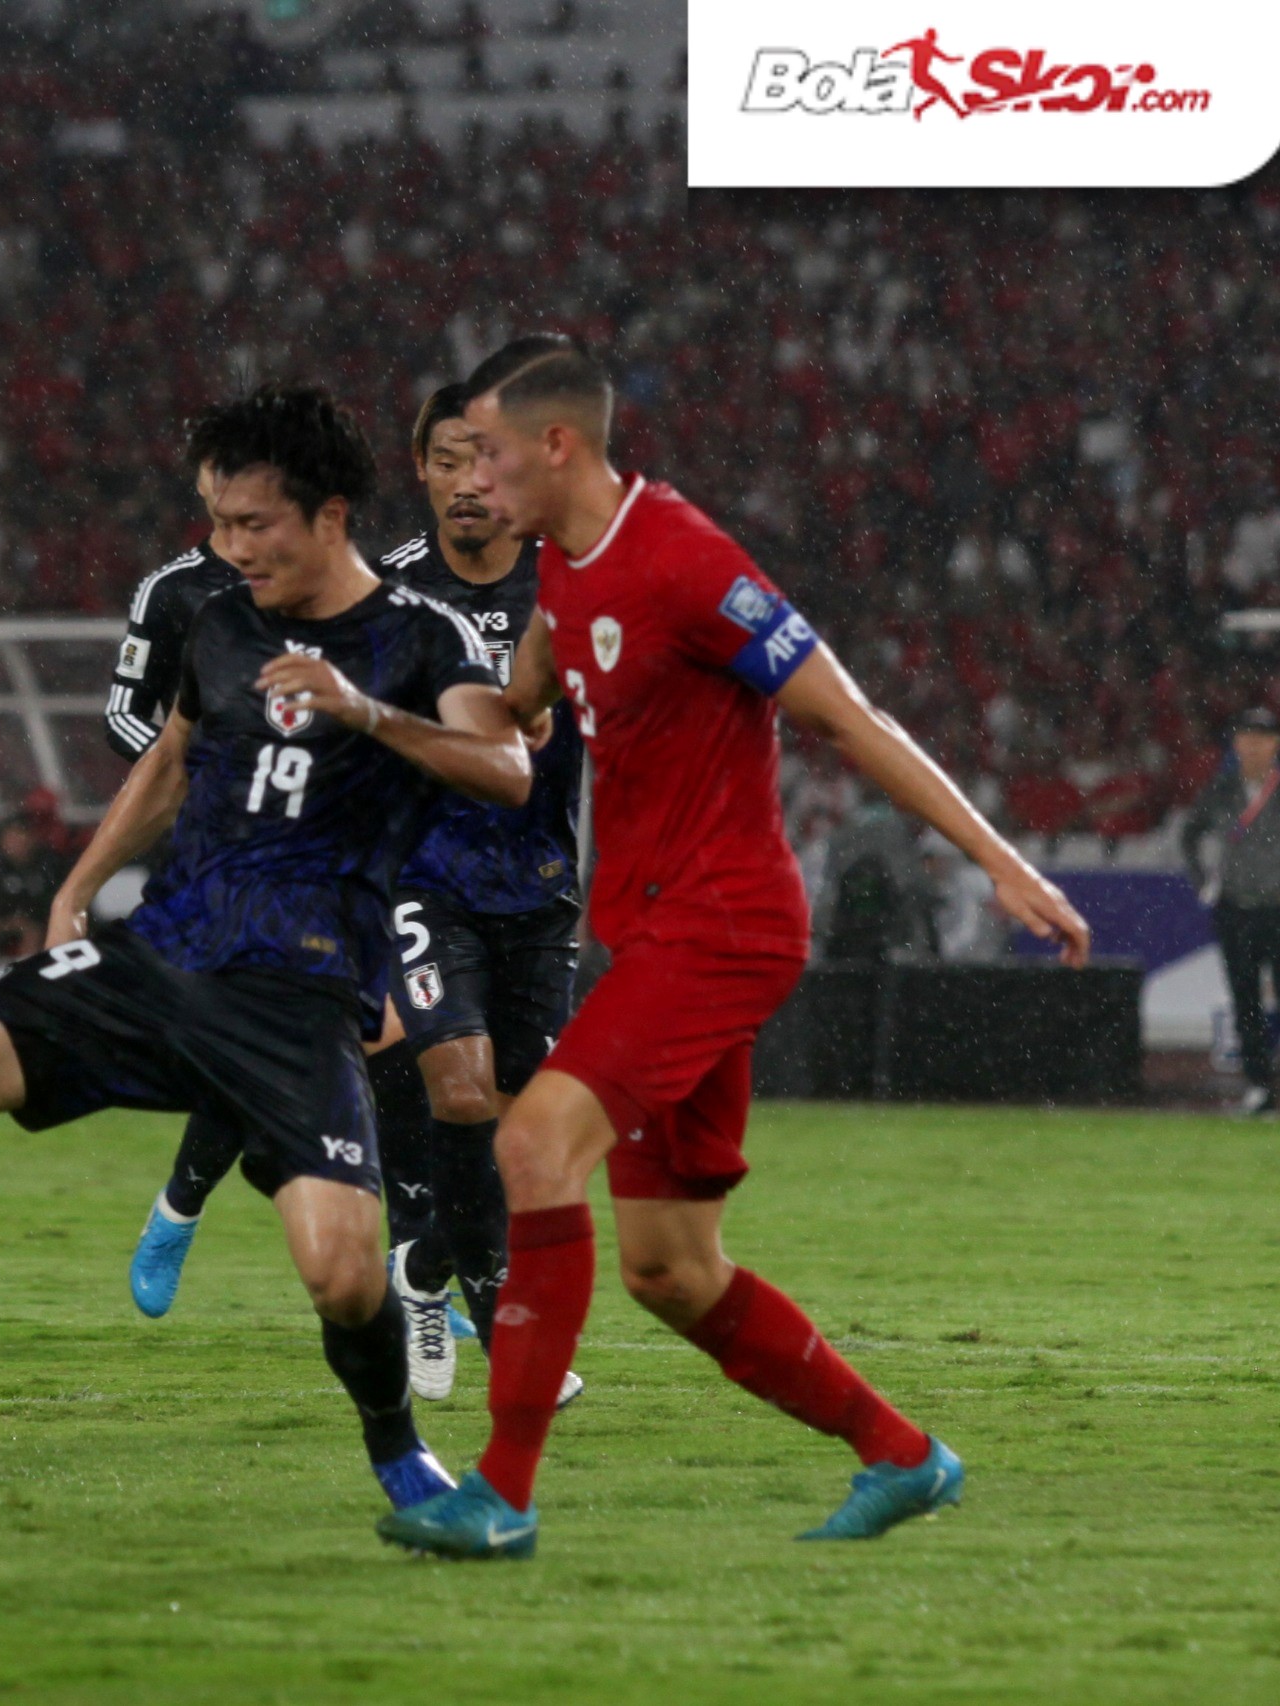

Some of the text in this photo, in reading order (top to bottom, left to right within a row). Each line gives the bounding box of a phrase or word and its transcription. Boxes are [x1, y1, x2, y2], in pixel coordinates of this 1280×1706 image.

[471, 611, 509, 632] Y-3
[764, 612, 815, 676] AFC
[246, 744, 314, 818] 19
[394, 901, 431, 964] 5
[321, 1134, 364, 1167] Y-3
